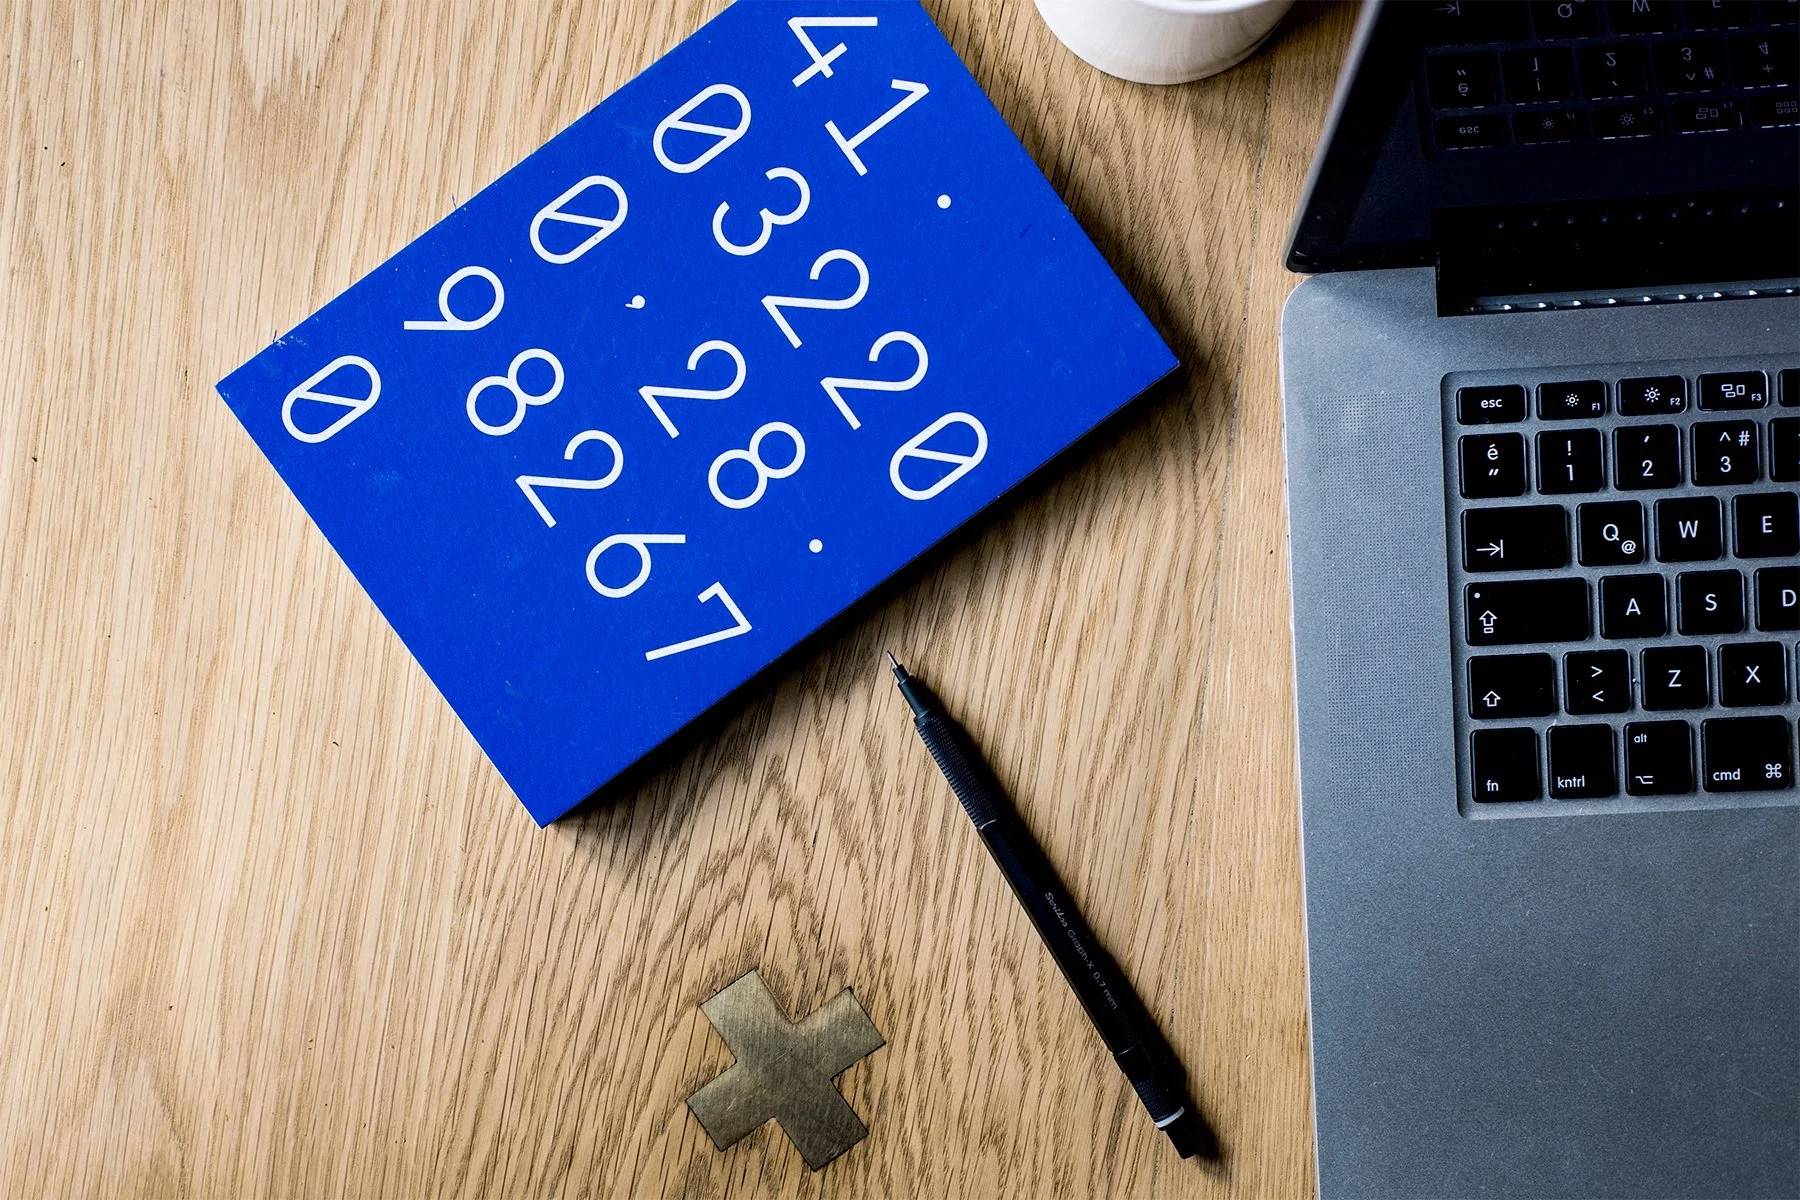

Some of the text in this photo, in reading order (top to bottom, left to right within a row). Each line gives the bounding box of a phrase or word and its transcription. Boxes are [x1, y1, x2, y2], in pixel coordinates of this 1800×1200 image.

[282, 356, 381, 443] 0
[1480, 399, 1503, 409] esc
[1670, 397, 1681, 405] F2
[1751, 393, 1761, 401] F3
[1591, 403, 1600, 411] F1
[1738, 430, 1751, 447] #
[1487, 443, 1499, 461] é
[1567, 440, 1572, 456] !
[1566, 464, 1574, 481] 1
[1642, 459, 1654, 477] 2
[1720, 456, 1732, 473] 3
[1603, 523, 1620, 541] Q
[1678, 520, 1698, 539] W
[1762, 515, 1773, 533] E
[1621, 541, 1636, 554] @
[1625, 598, 1641, 616] A
[1705, 594, 1718, 612] S
[1782, 590, 1797, 607] D
[1668, 670, 1682, 687] Z
[1745, 665, 1760, 684] X
[1634, 733, 1647, 743] alt
[1557, 775, 1585, 789] kntrl
[1713, 768, 1741, 782] cmd
[1486, 779, 1499, 792] fn
[1093, 971, 1107, 987] 0.7
[1103, 989, 1118, 1010] mm
